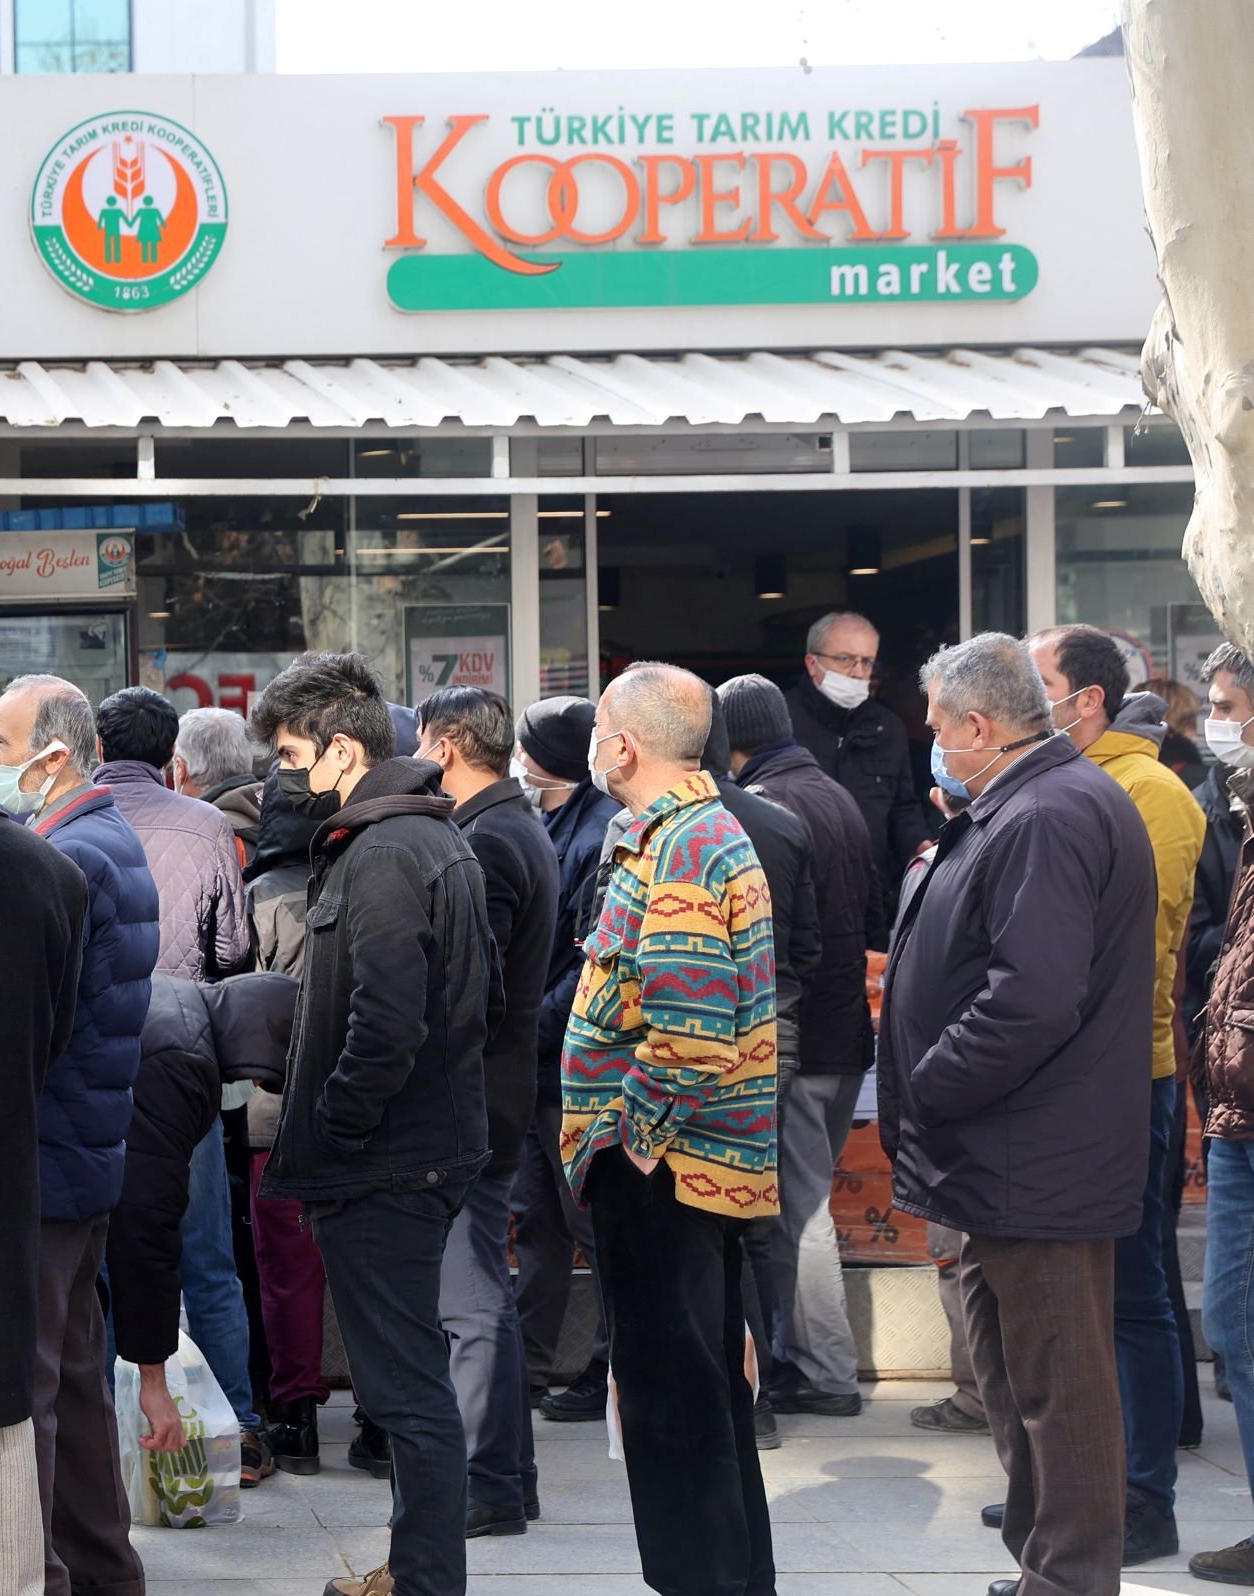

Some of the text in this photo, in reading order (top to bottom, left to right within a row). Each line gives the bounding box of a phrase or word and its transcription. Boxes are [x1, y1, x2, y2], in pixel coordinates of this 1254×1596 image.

[510, 100, 940, 146] TÜRKİYE TARIM KREDİ
[40, 120, 220, 219] TÜRKİYE TARIM KREDİ KOOPERATİFLERİ
[381, 103, 1039, 277] KOOPERATİF
[114, 285, 150, 300] 1863
[830, 249, 1018, 296] market
[36, 548, 90, 578] Beslen
[459, 653, 495, 673] KDV
